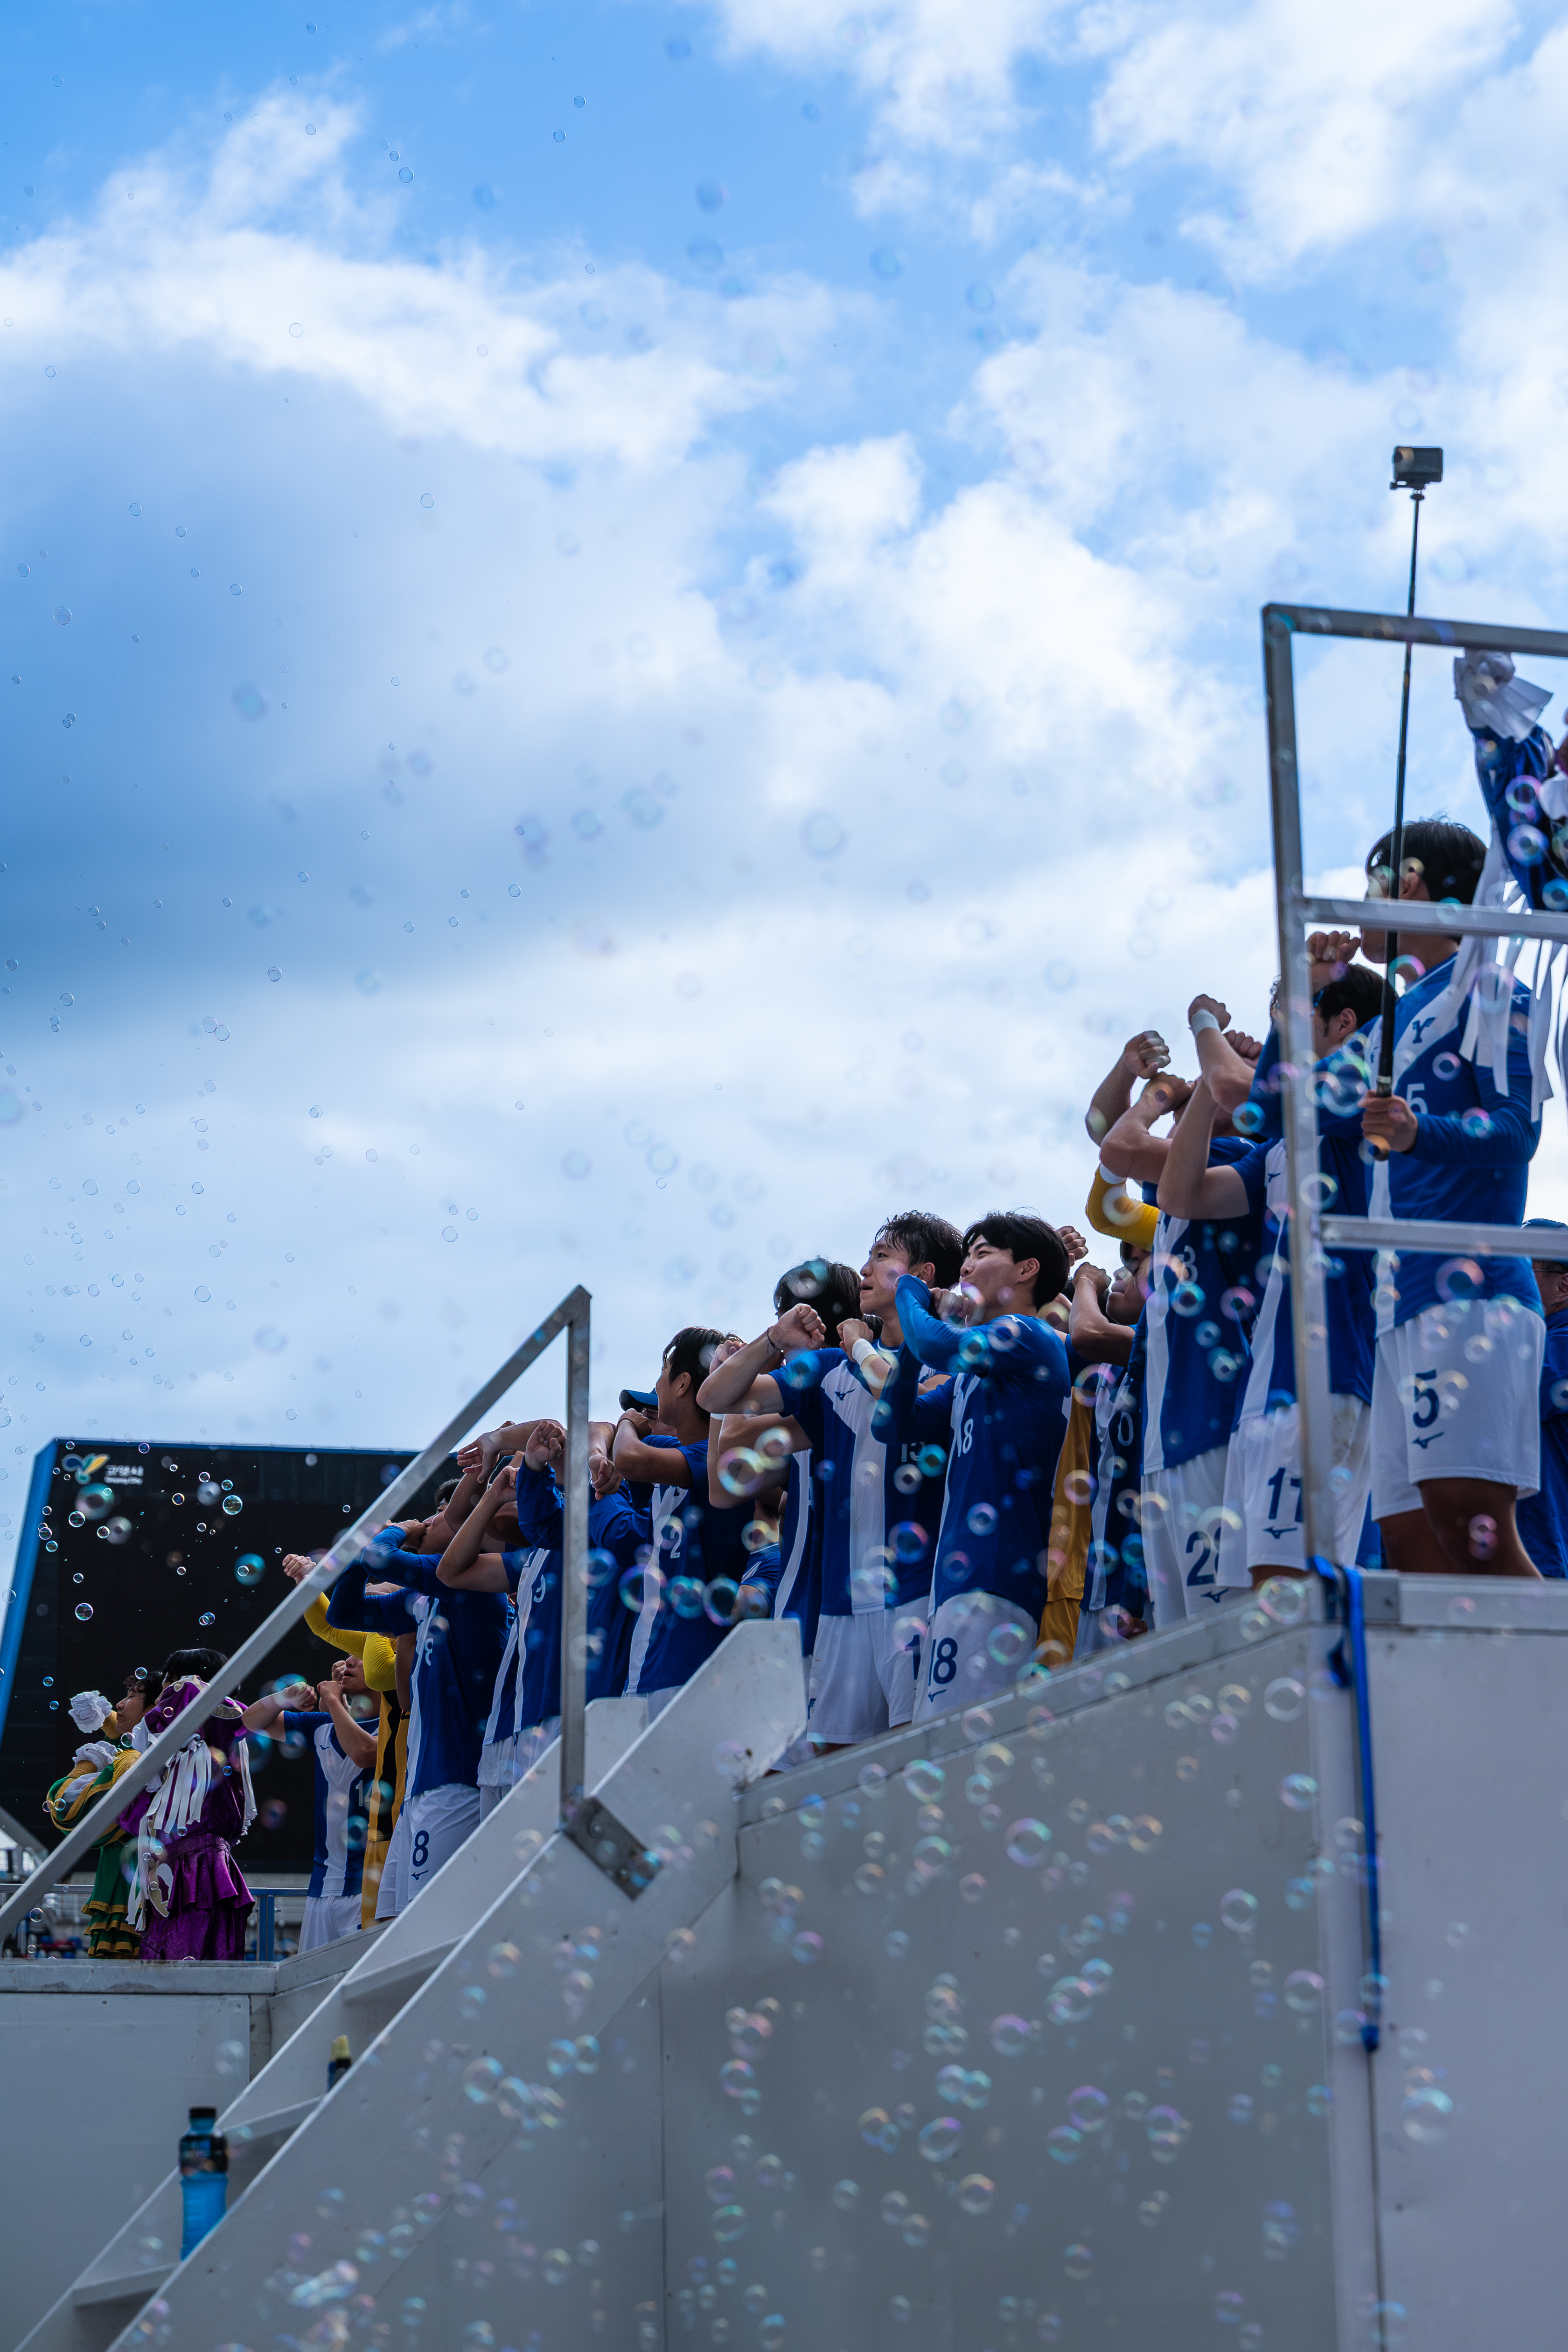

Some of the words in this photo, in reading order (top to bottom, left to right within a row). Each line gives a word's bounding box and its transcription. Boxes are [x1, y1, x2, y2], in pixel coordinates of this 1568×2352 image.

[1406, 1083, 1428, 1114] 5
[1413, 1369, 1439, 1428] 5
[928, 1637, 958, 1687] 18
[412, 1830, 430, 1867] 8
